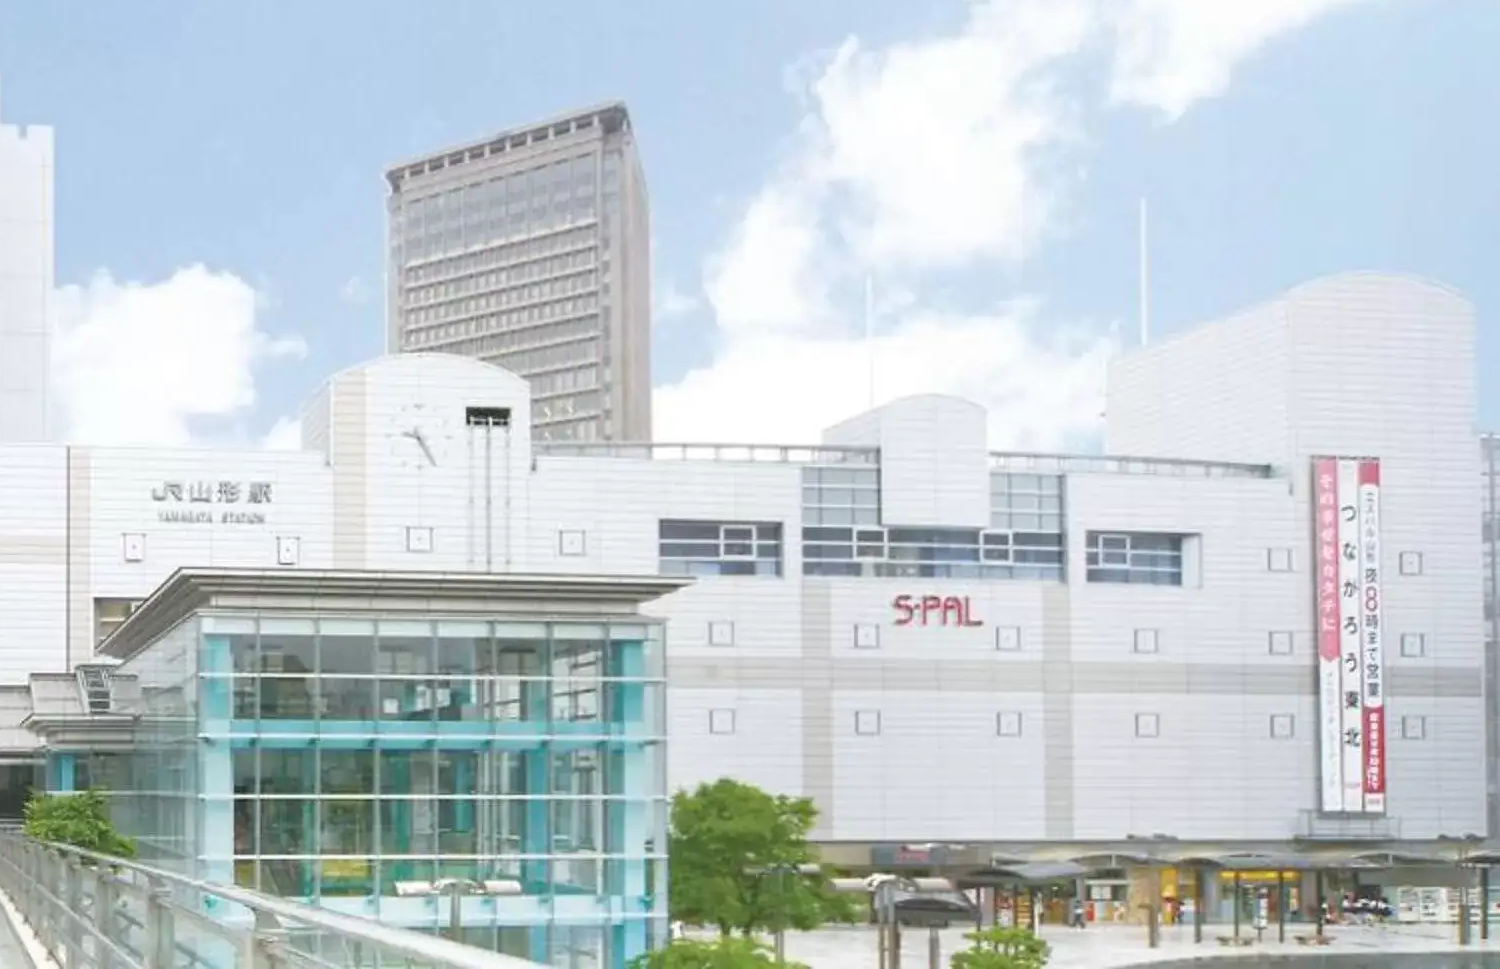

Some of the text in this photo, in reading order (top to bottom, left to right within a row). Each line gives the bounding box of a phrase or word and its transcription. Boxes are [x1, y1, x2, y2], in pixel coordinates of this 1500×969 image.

[151, 481, 273, 503] JR山形駅
[1341, 505, 1361, 748] つながろう東北
